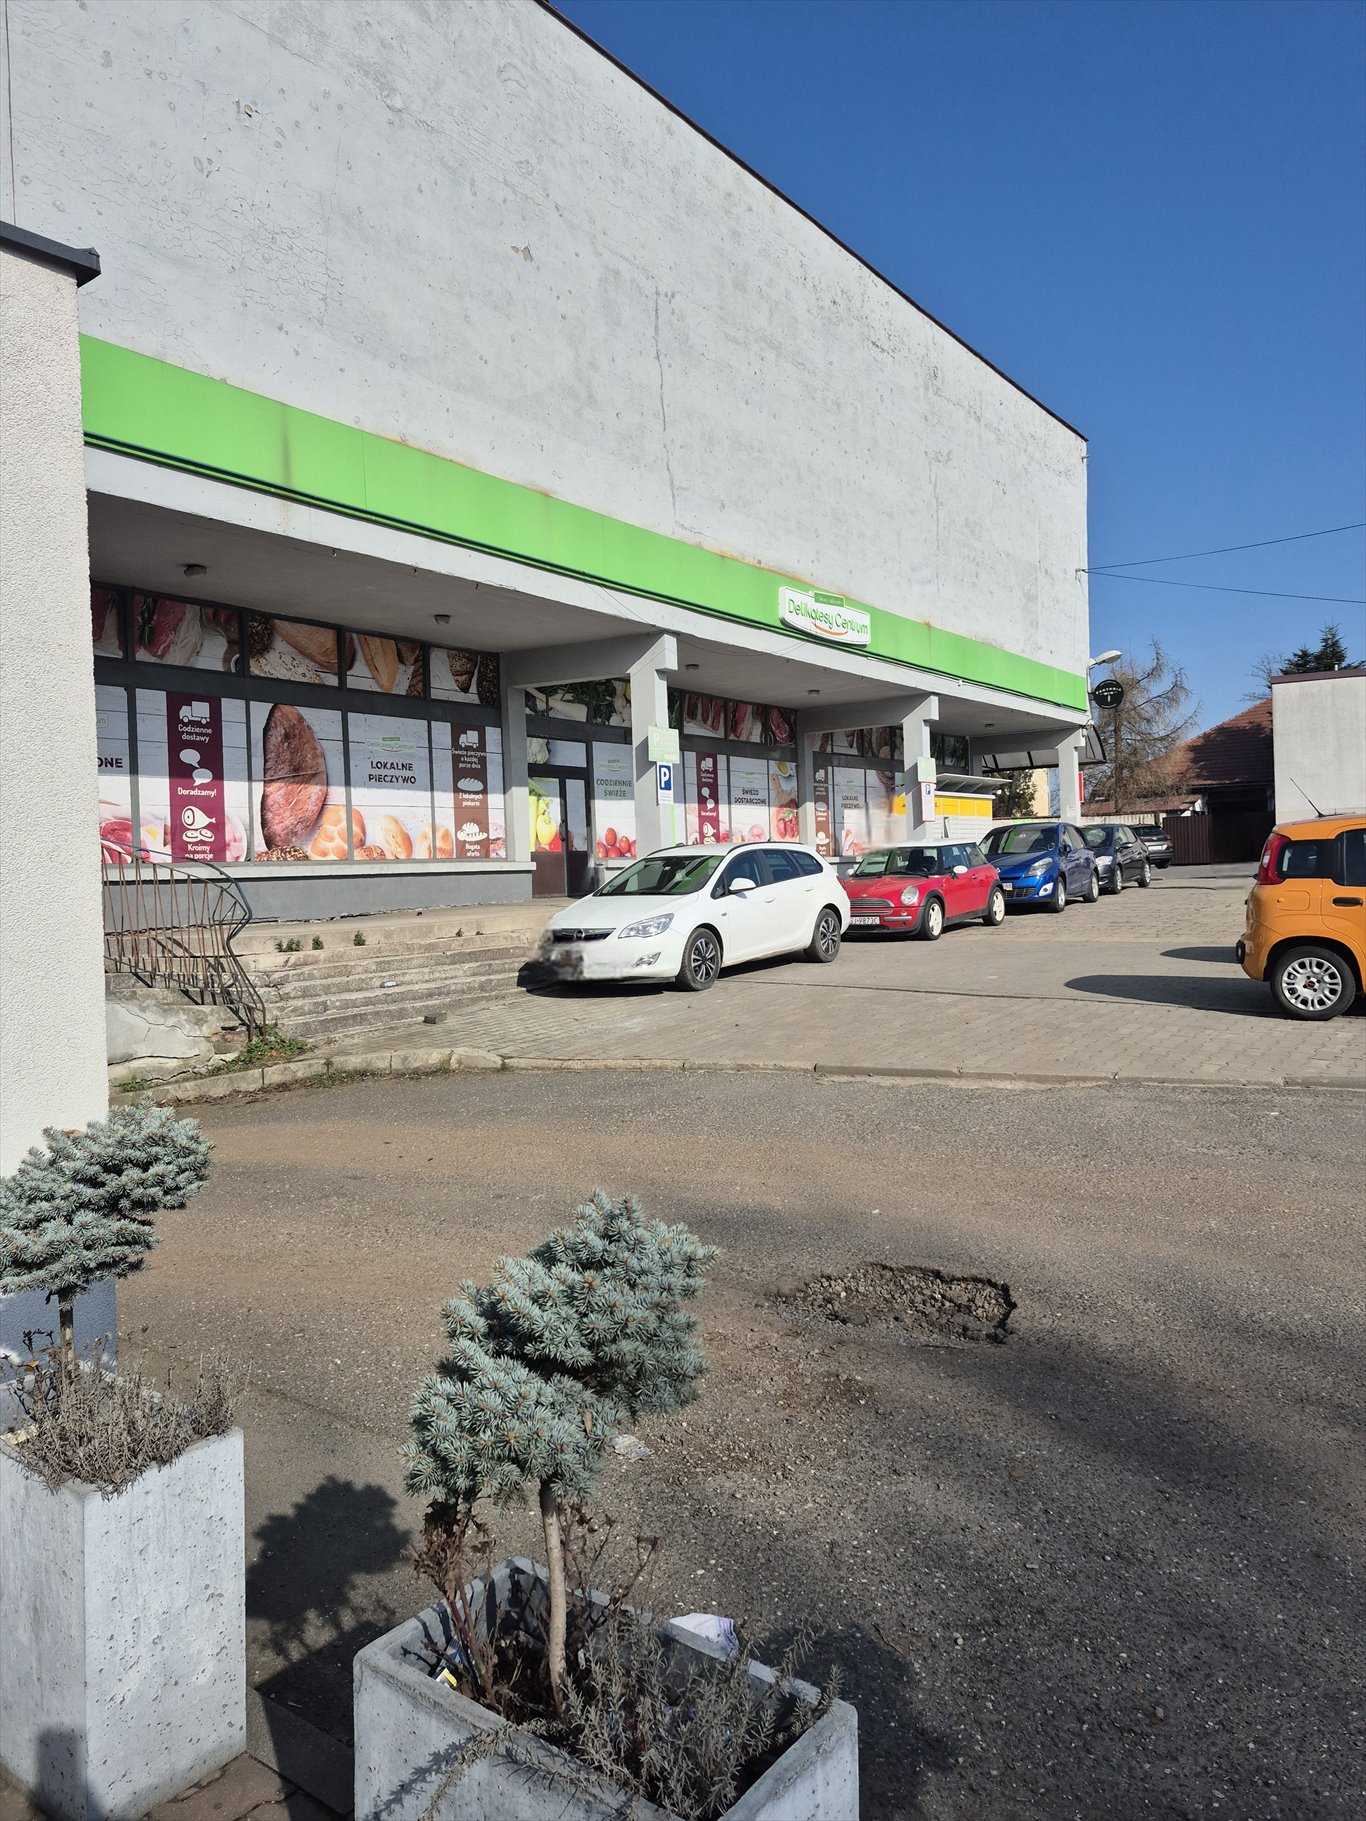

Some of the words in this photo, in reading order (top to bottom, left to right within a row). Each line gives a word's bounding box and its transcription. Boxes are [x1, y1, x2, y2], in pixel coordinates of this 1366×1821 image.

[788, 599, 834, 629] Delikatesy
[835, 613, 868, 635] Centrum
[178, 724, 212, 734] Codzienne
[181, 733, 210, 743] dostawy
[370, 760, 414, 771] LOKALNE
[368, 773, 417, 785] PIECZYWO
[596, 778, 633, 787] CODZIENNIE
[661, 767, 670, 788] P
[177, 787, 217, 798] Doradzamy!
[603, 787, 627, 797] ŚWIEŻE
[187, 843, 211, 853] Kroimy
